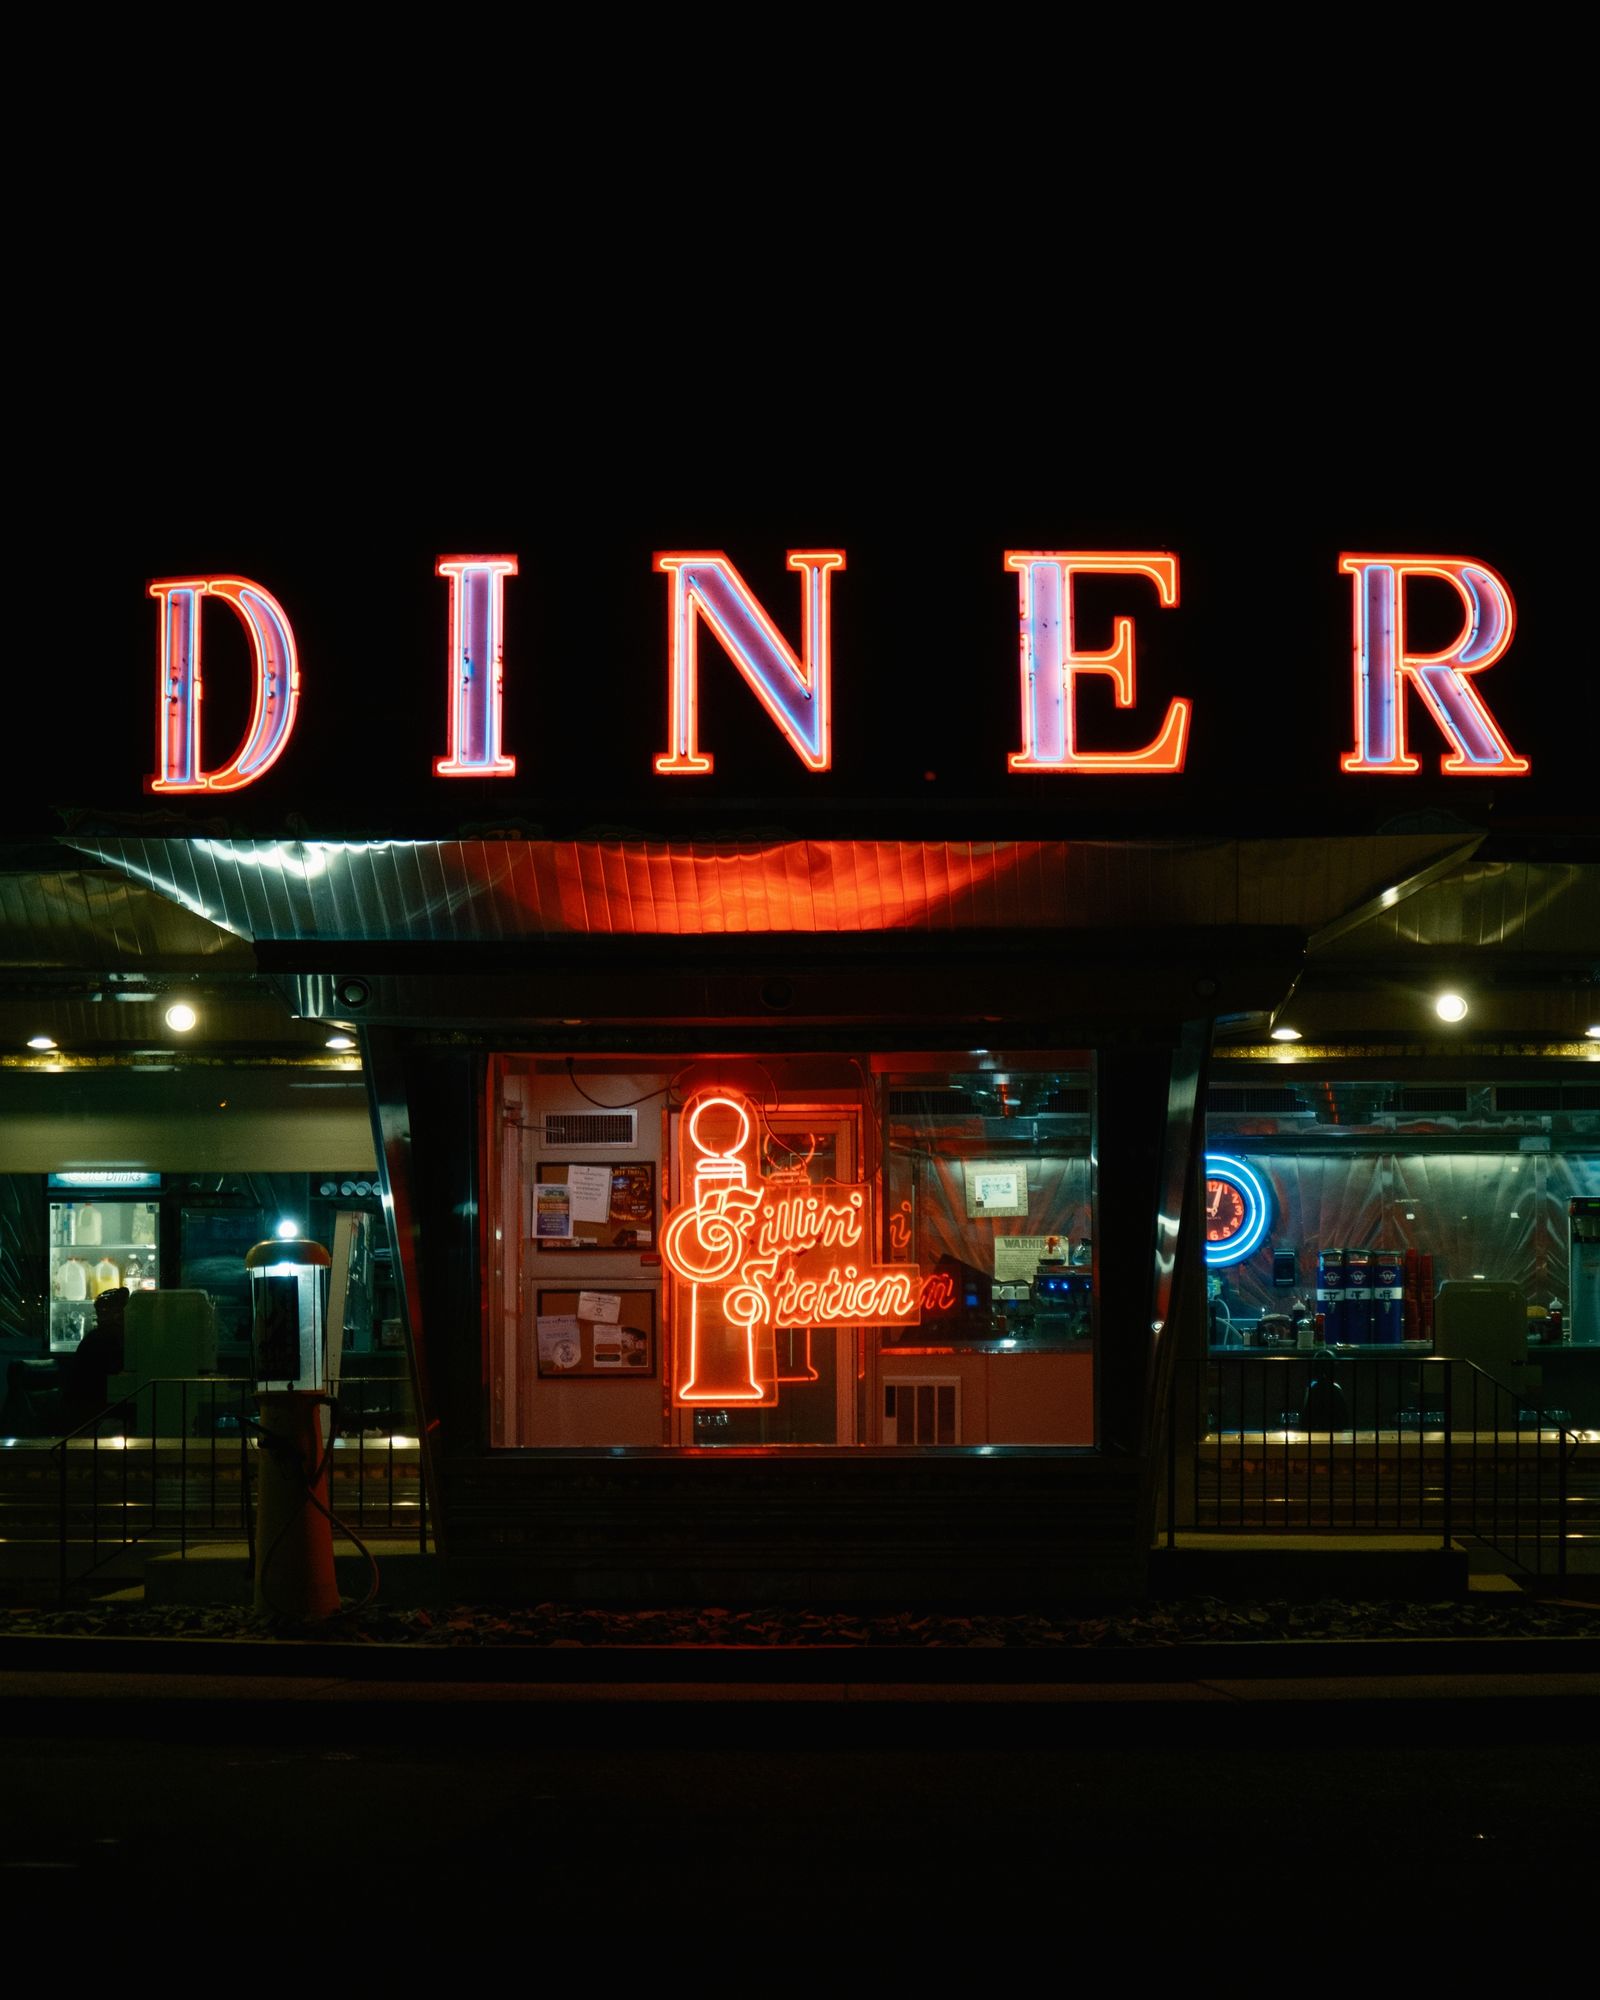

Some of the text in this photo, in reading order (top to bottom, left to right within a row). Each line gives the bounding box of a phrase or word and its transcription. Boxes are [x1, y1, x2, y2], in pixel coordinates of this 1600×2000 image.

[144, 549, 1531, 795] DINER
[105, 1171, 142, 1182] Drinks
[1223, 1183, 1229, 1195] 1
[1231, 1193, 1240, 1204] 2
[1234, 1205, 1243, 1216] 3
[1230, 1217, 1239, 1228] 4
[666, 1186, 863, 1283] Fillin'
[1209, 1230, 1219, 1241] 6
[1222, 1227, 1231, 1238] 5
[1004, 1239, 1047, 1249] WARNIN
[722, 1254, 915, 1327] Station
